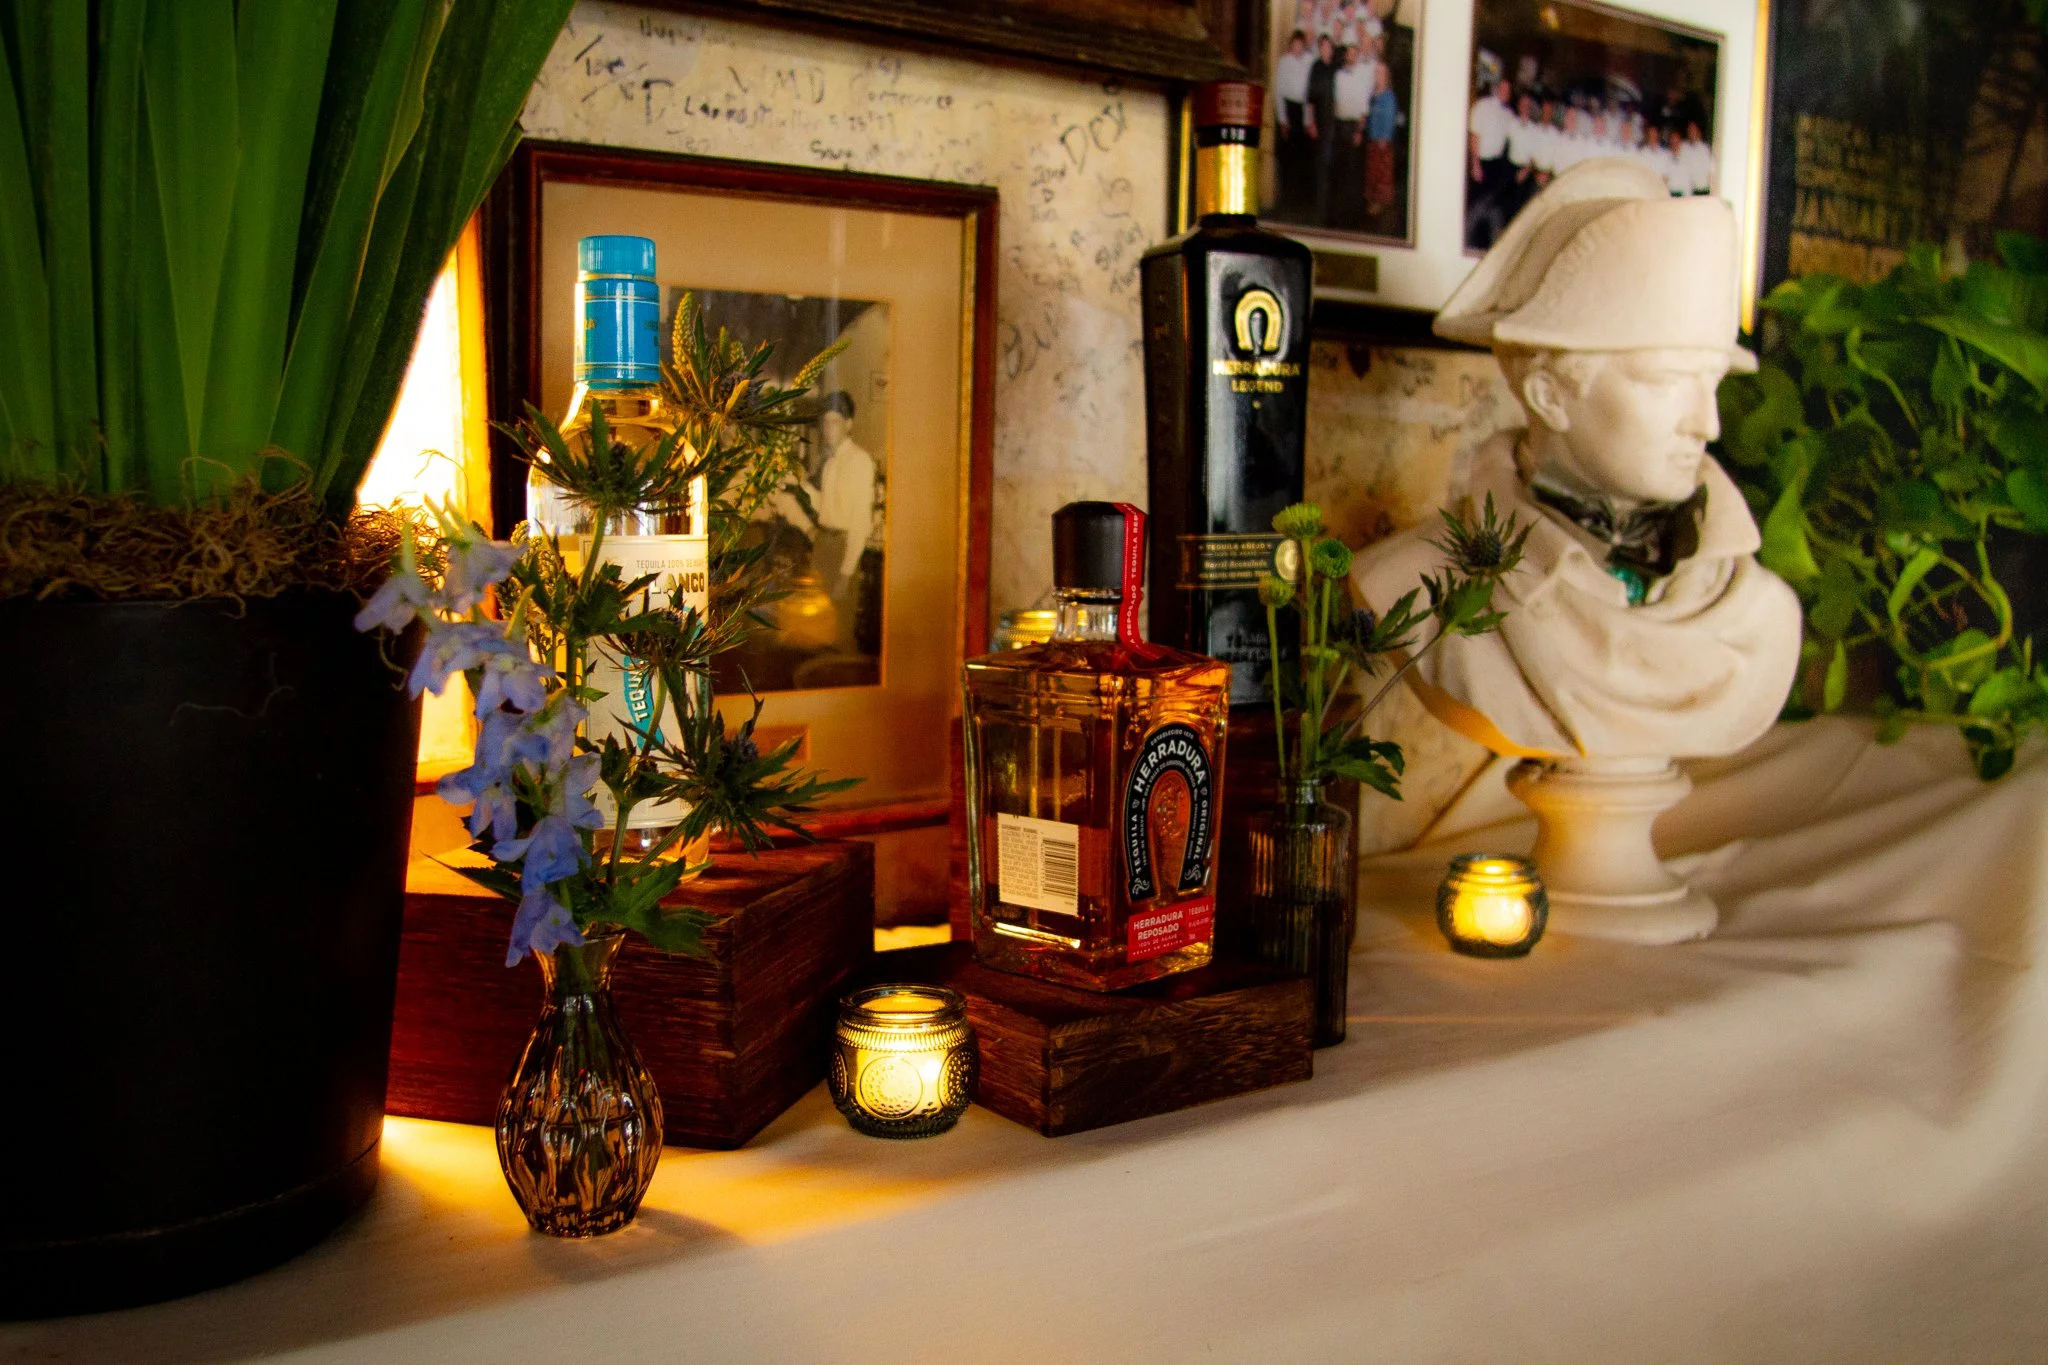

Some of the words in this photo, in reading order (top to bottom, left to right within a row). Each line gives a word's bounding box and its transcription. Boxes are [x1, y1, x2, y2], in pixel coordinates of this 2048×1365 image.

[637, 560, 665, 568] TEQUILA
[1130, 536, 1138, 579] TEQUILA
[641, 575, 704, 597] LANCO
[1134, 739, 1206, 794] HERRADURA
[1192, 799, 1208, 861] ORIGINAL
[1131, 814, 1143, 874] TEQUILA
[1188, 904, 1209, 915] TEQUILA
[1133, 911, 1184, 931] HERRADURA
[1137, 923, 1180, 941] REPOSADO
